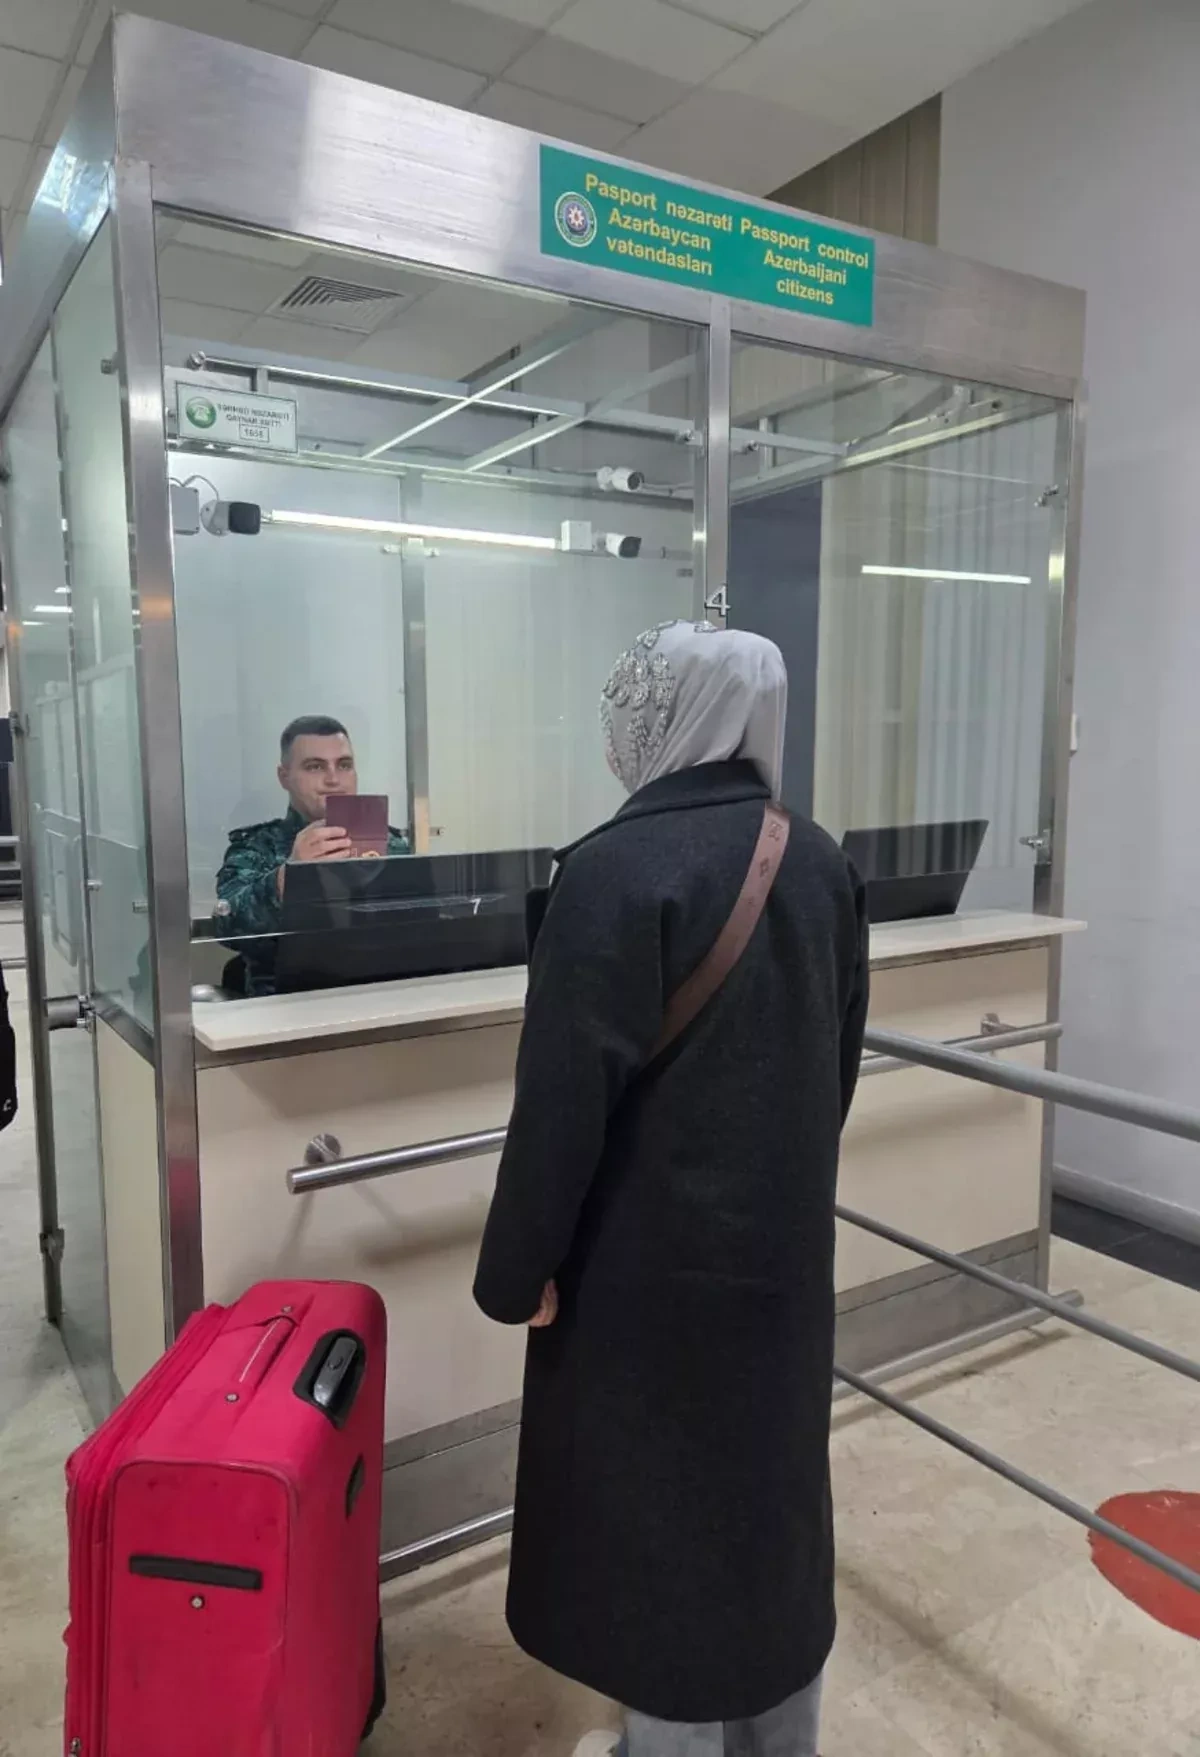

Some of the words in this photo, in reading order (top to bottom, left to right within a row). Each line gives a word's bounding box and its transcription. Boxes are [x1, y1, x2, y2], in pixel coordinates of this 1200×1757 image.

[586, 173, 657, 209] Pasport
[666, 201, 733, 232] nəzarəti
[608, 209, 711, 251] Azərbaycan
[740, 217, 810, 252] Passport
[817, 242, 868, 269] control
[764, 249, 847, 285] Azerbaijani
[776, 279, 834, 305] citizens
[705, 584, 731, 617] 4
